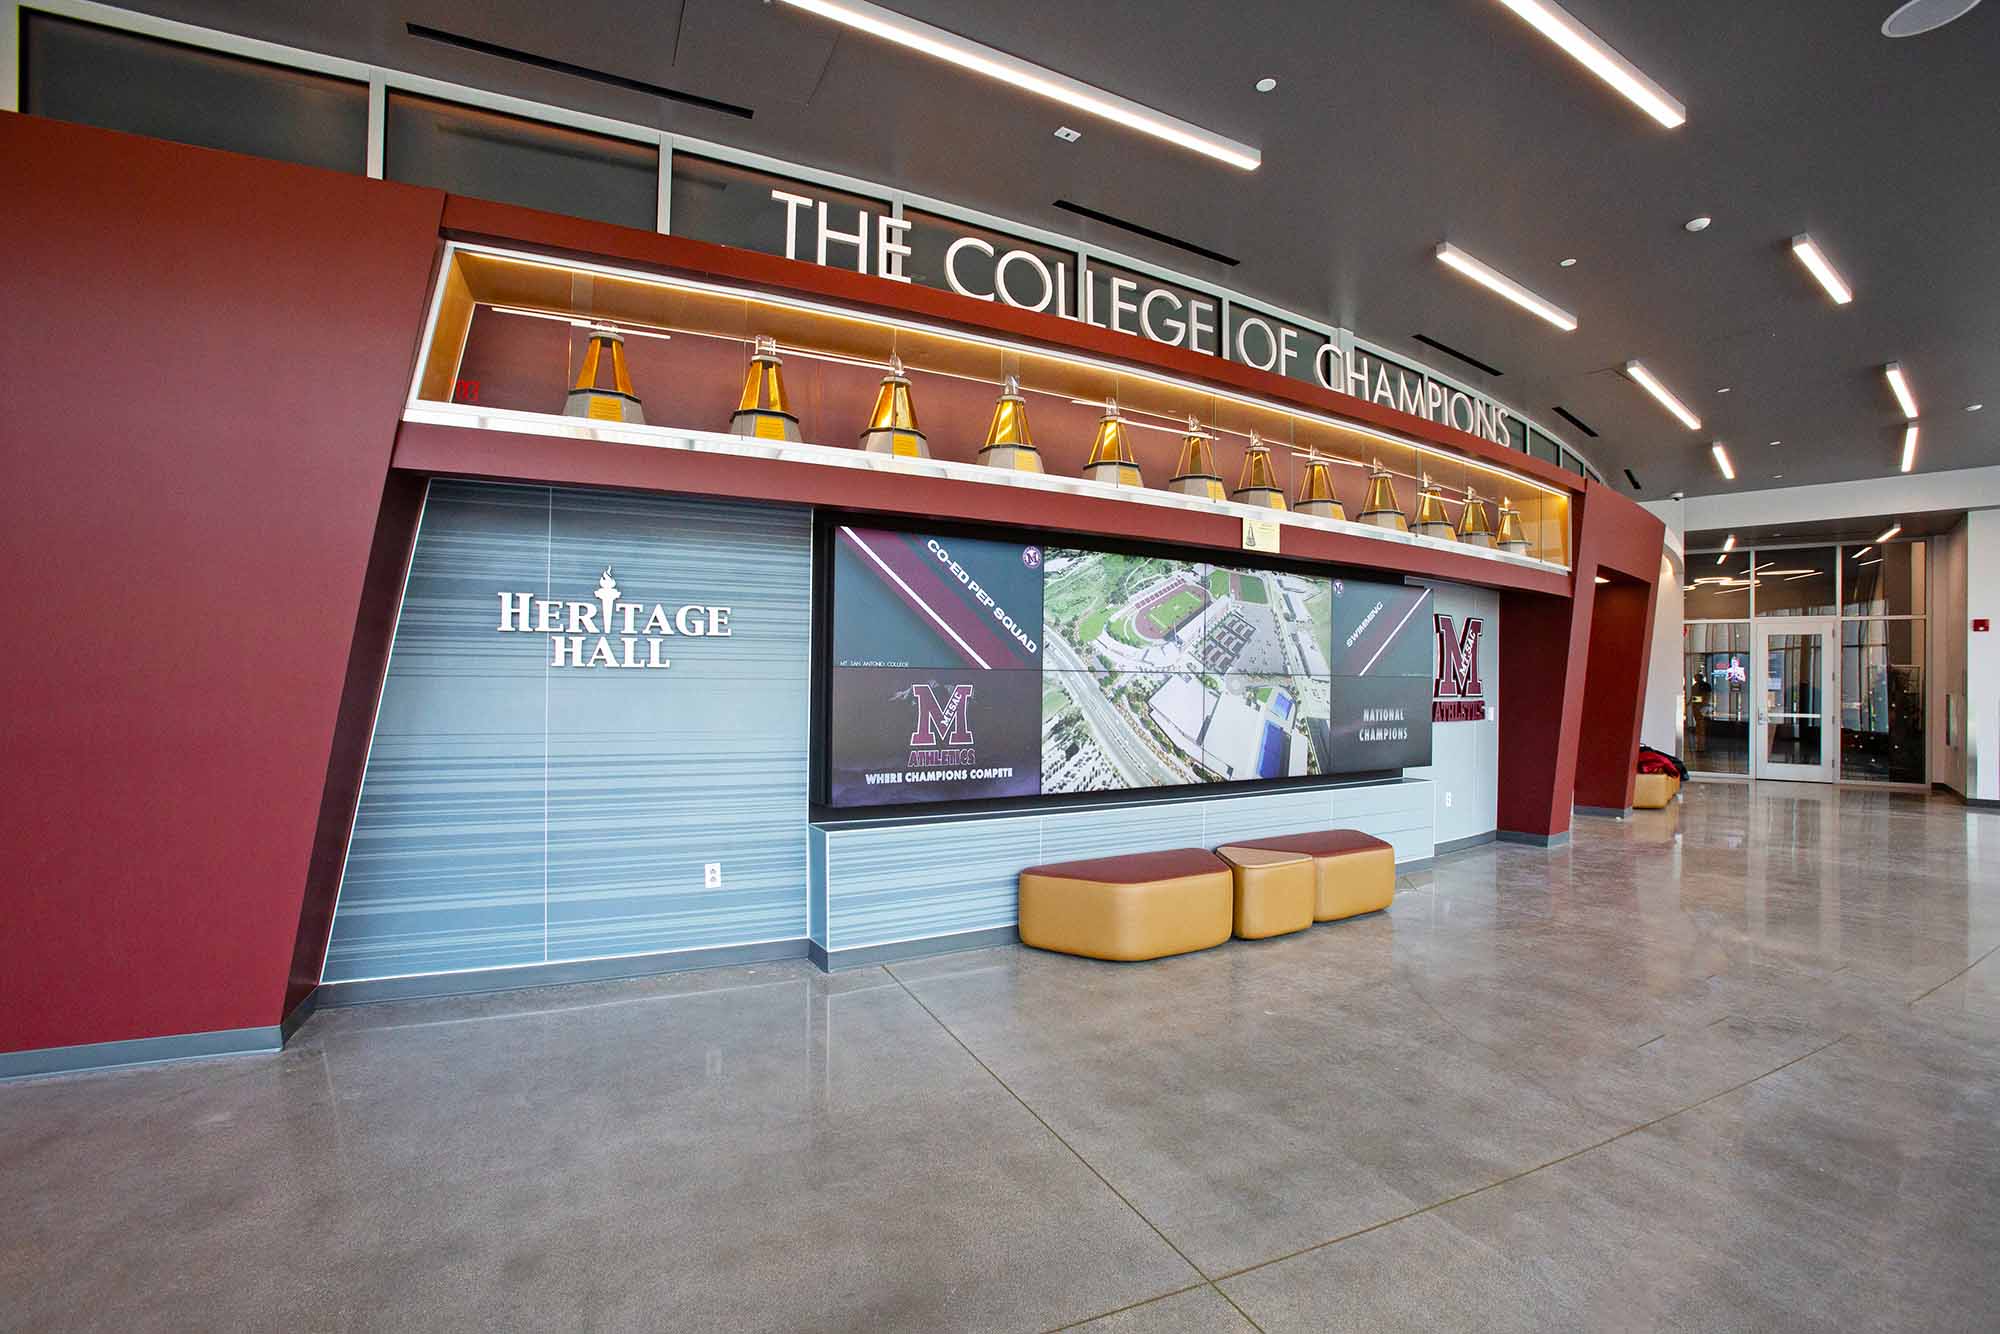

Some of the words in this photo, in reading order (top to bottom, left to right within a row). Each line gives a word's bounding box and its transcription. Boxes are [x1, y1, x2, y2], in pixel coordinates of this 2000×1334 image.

[771, 190, 912, 283] THE
[944, 236, 1215, 356] COLLEGE
[1238, 318, 1298, 376] OF
[1315, 342, 1511, 448] CHAMPIONS
[497, 566, 732, 637] HERITAGE
[927, 539, 970, 584] CO-ED
[967, 580, 995, 608] PEP
[993, 607, 1038, 654] SQUAD
[551, 636, 671, 669] HALL
[1433, 614, 1484, 697] M
[910, 684, 974, 746] M
[1359, 727, 1408, 742] CHAMPIONS
[1363, 708, 1404, 722] NATIONAL
[865, 772, 903, 785] WHERE
[905, 769, 968, 783] CHAMPIONS
[970, 767, 1013, 779] COMPETE
[907, 748, 977, 768] ATHLETICS
